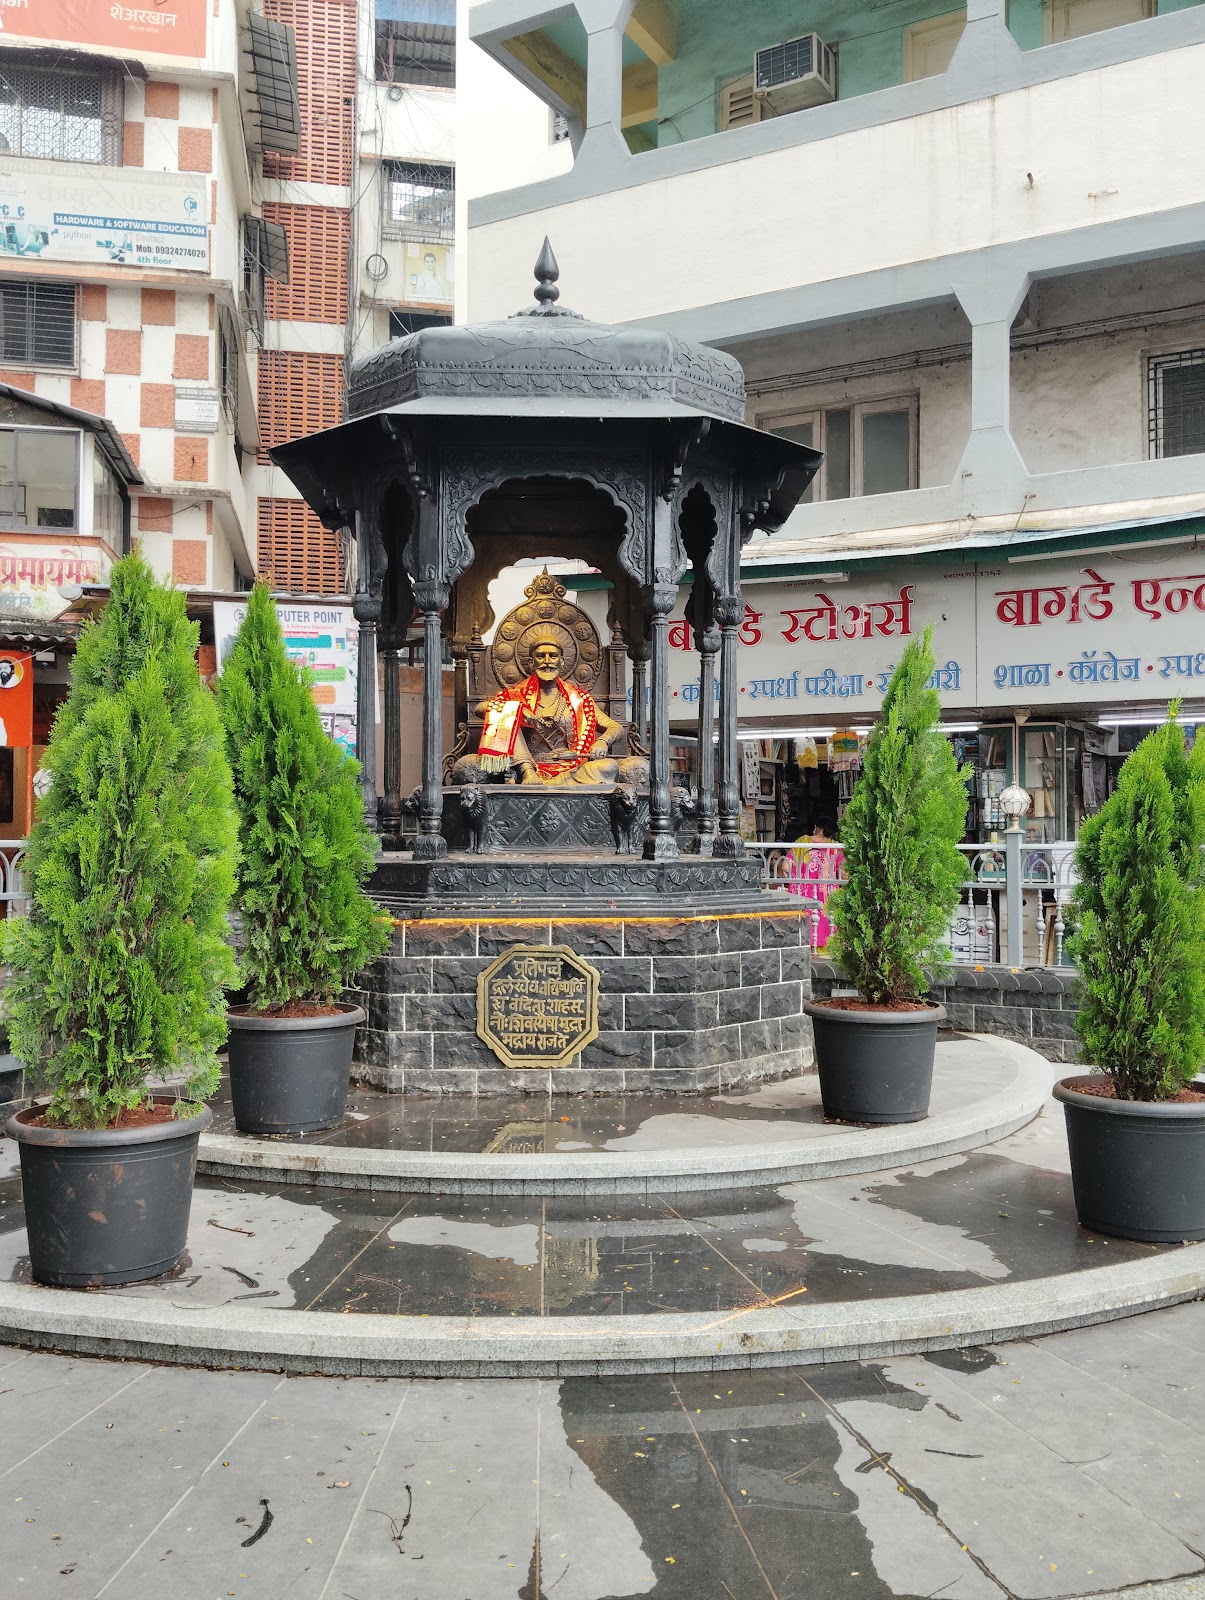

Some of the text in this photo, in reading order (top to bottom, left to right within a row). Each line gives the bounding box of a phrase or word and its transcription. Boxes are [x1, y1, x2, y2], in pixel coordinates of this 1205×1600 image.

[110, 2, 178, 27] शेअरखान
[56, 215, 205, 235] HARDWARE & SOFTWARE EDUCATION
[63, 229, 92, 241] python
[137, 256, 172, 265] 4th floor
[155, 245, 206, 259] 09324274026
[994, 568, 1116, 627] बागडे
[314, 611, 343, 624] POINT
[780, 584, 916, 644] स्टोअर्स
[994, 663, 1052, 689] शाळा
[1068, 651, 1142, 683] कॉलेज
[749, 670, 800, 700] स्पर्धा
[805, 668, 865, 699] परीक्षा
